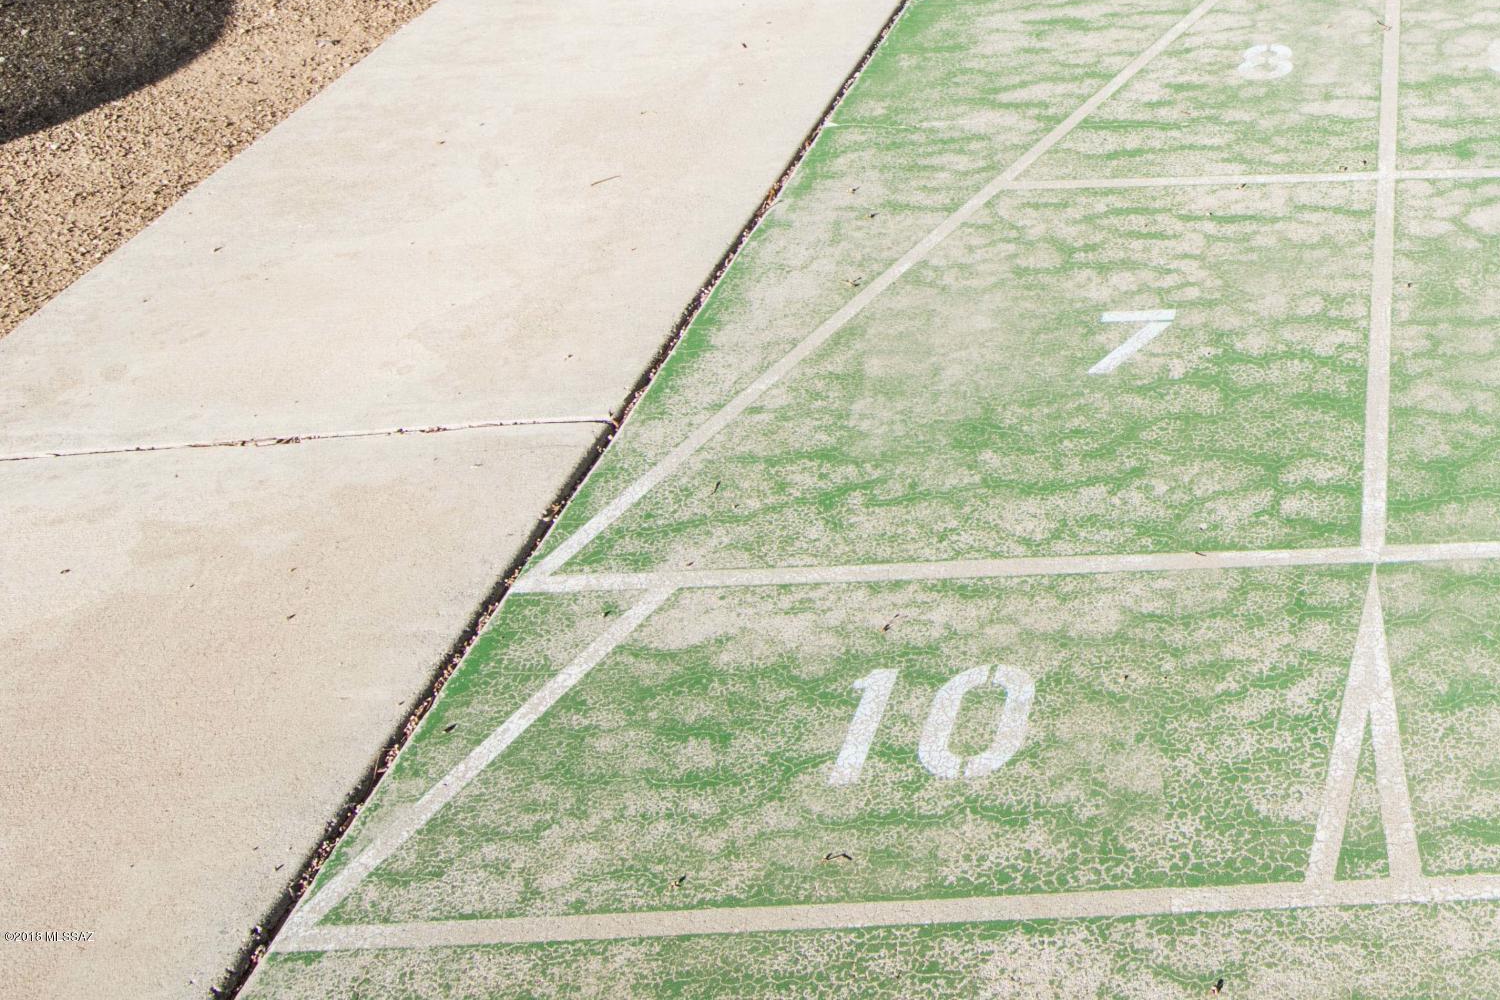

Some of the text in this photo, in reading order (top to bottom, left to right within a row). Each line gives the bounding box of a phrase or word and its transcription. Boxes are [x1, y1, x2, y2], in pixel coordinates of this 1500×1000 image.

[1238, 44, 1293, 79] 8
[1088, 309, 1177, 375] 7
[825, 663, 1036, 787] 10
